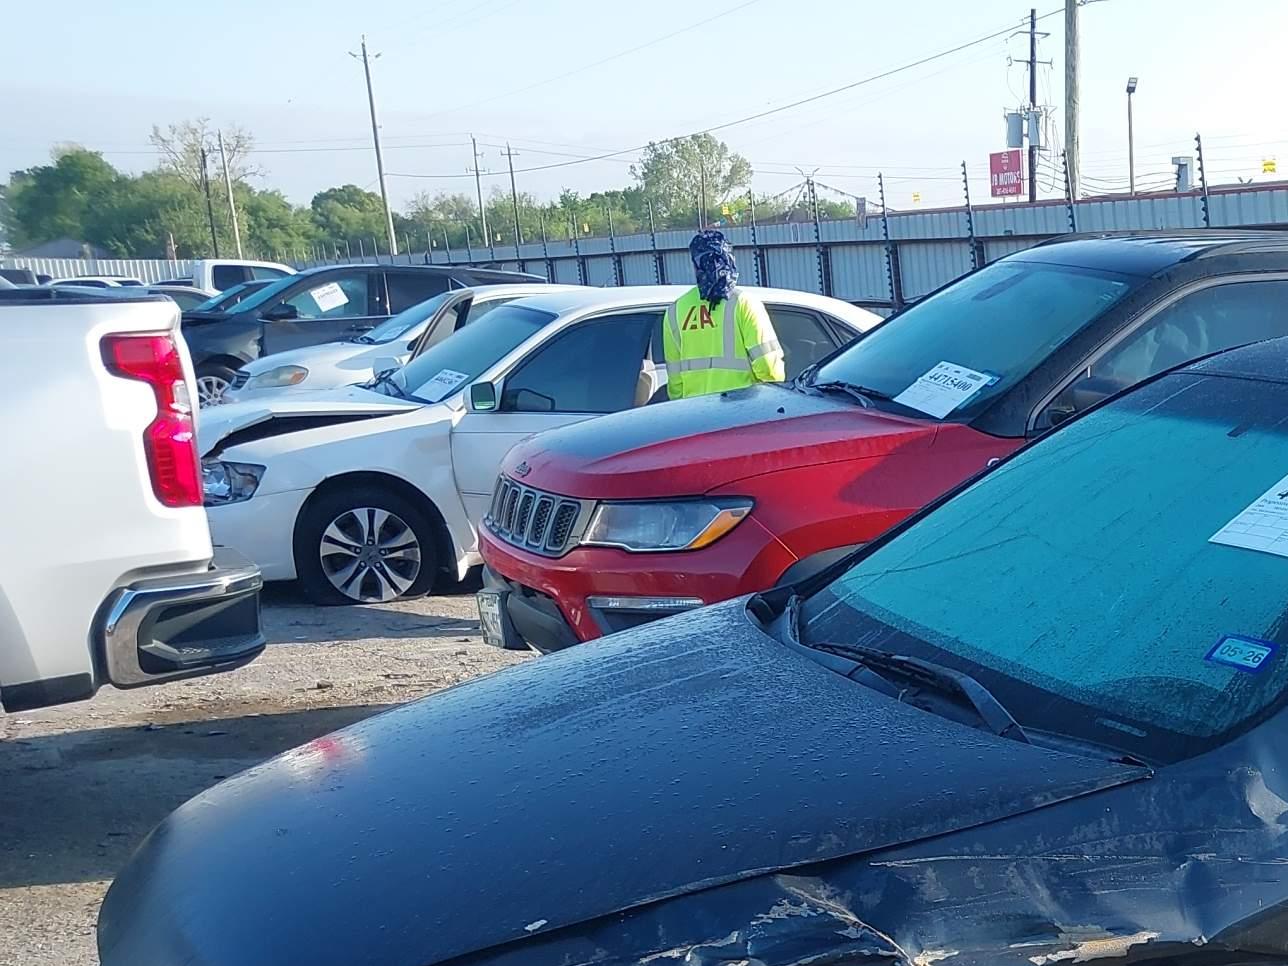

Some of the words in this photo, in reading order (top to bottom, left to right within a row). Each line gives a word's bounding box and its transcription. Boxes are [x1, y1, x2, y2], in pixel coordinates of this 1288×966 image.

[999, 170, 1021, 186] MOTORS
[928, 372, 973, 392] 44715400
[1220, 644, 1240, 658] 05
[1243, 650, 1265, 664] 26
